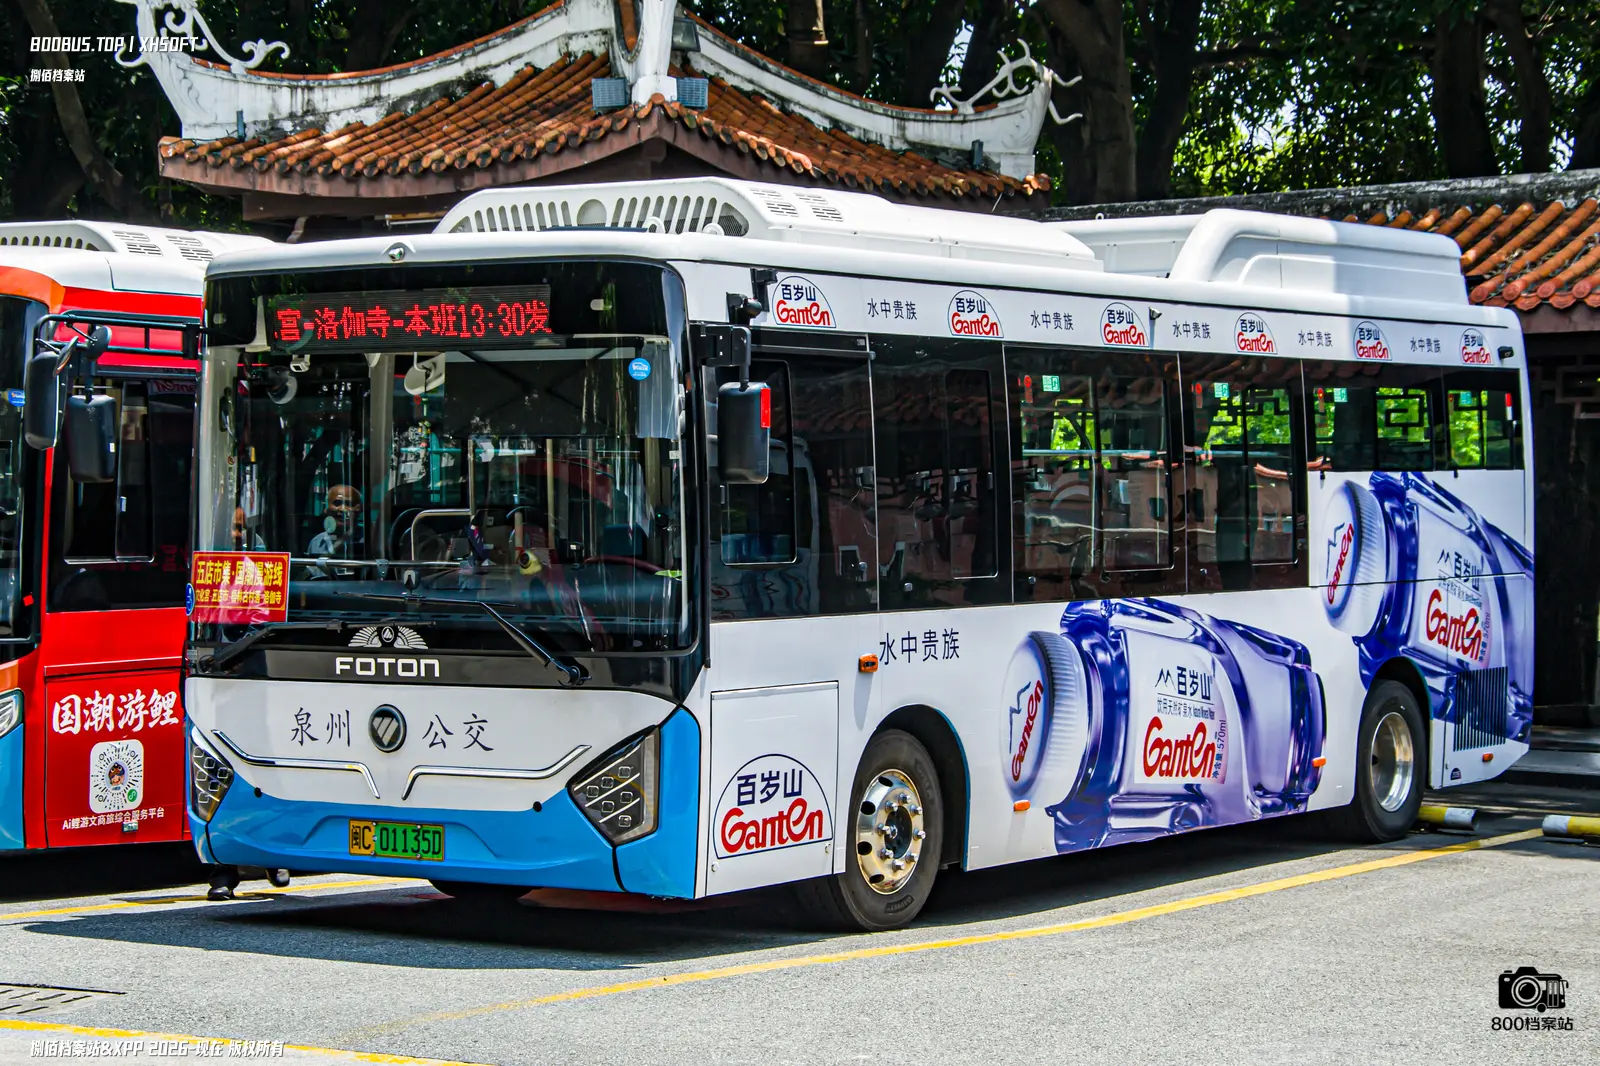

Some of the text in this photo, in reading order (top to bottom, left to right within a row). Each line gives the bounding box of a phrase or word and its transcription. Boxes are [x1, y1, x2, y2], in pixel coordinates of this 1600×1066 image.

[781, 284, 816, 301] 百岁山
[776, 299, 831, 326] Ganten
[867, 298, 918, 320] 水中贵族
[956, 298, 987, 314] 百岁山
[1107, 309, 1134, 325] 百岁山
[274, 300, 552, 341] 宫-洛伽寺-本班13:30发
[951, 311, 999, 337] Ganten
[1030, 310, 1074, 331] 水中贵族
[1172, 321, 1211, 339] 水中贵族
[1240, 319, 1264, 333] 百岁山
[1103, 323, 1145, 345] Ganten
[1298, 330, 1333, 347] 水中贵族
[1358, 327, 1380, 341] 百岁山
[1410, 337, 1441, 353] 水中贵族
[880, 628, 960, 665] 水中贵族
[335, 657, 440, 677] FOTON
[1176, 666, 1211, 701] 百岁山
[52, 689, 179, 735] 国潮游鲤
[291, 707, 494, 751] 泉州 公交
[1143, 716, 1216, 778] Ganten
[737, 769, 802, 806] 百岁山
[721, 798, 824, 853] Ganten
